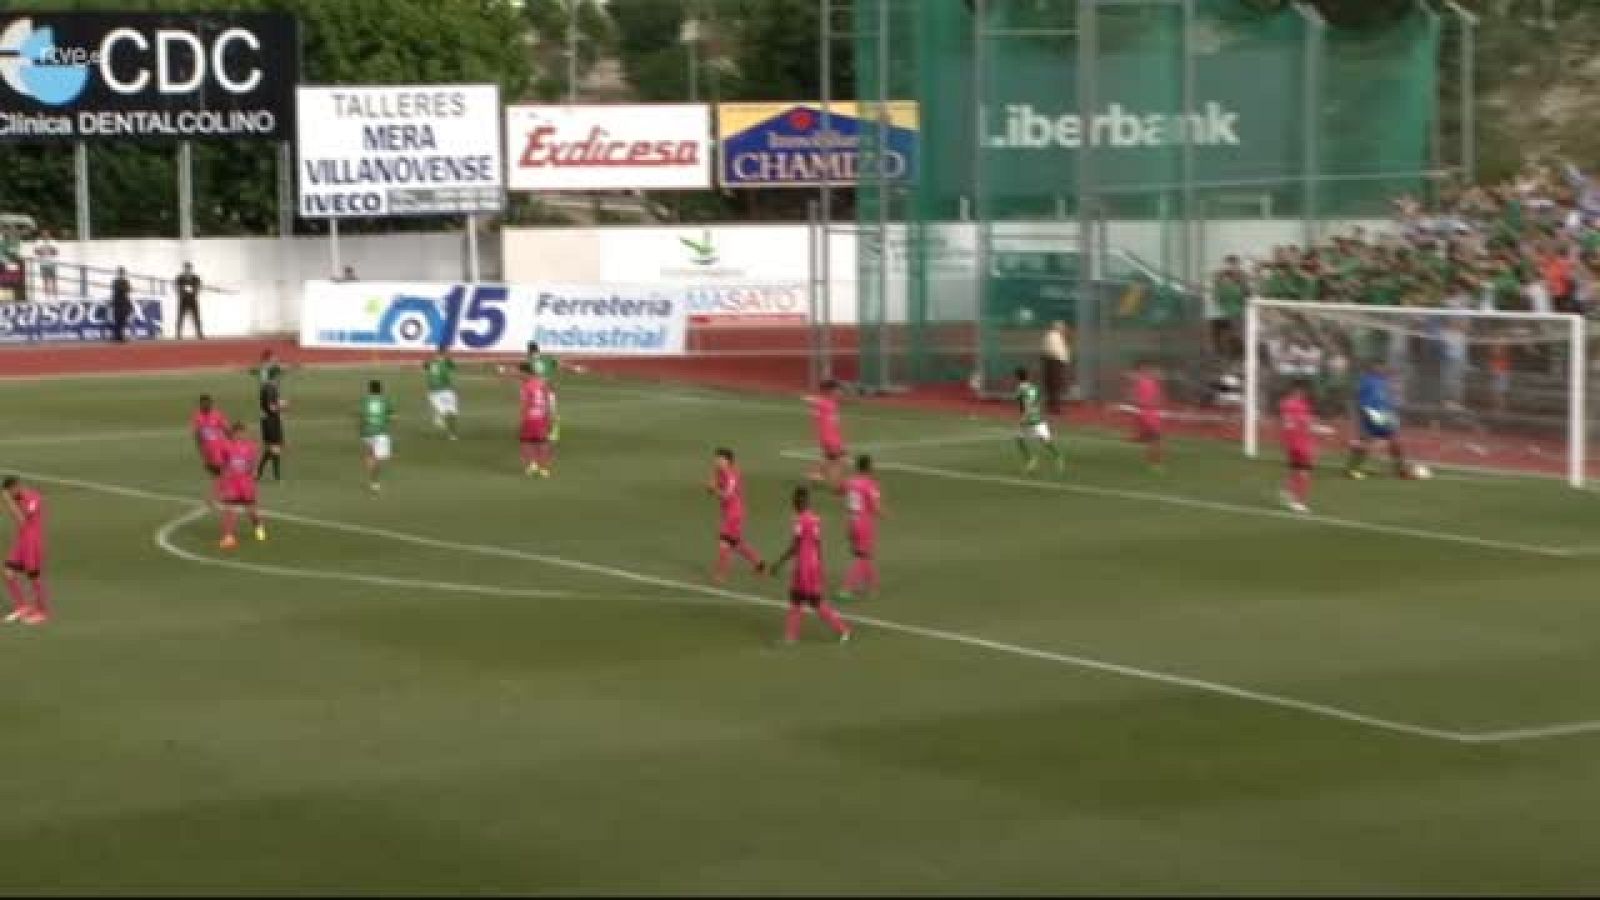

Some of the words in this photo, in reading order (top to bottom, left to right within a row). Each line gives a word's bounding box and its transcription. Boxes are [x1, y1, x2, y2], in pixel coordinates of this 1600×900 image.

[100, 27, 264, 94] CDC
[331, 91, 467, 118] TALLERES
[363, 124, 436, 150] MERA
[305, 154, 494, 184] VILLANOVENSE
[304, 192, 381, 213] IVECO
